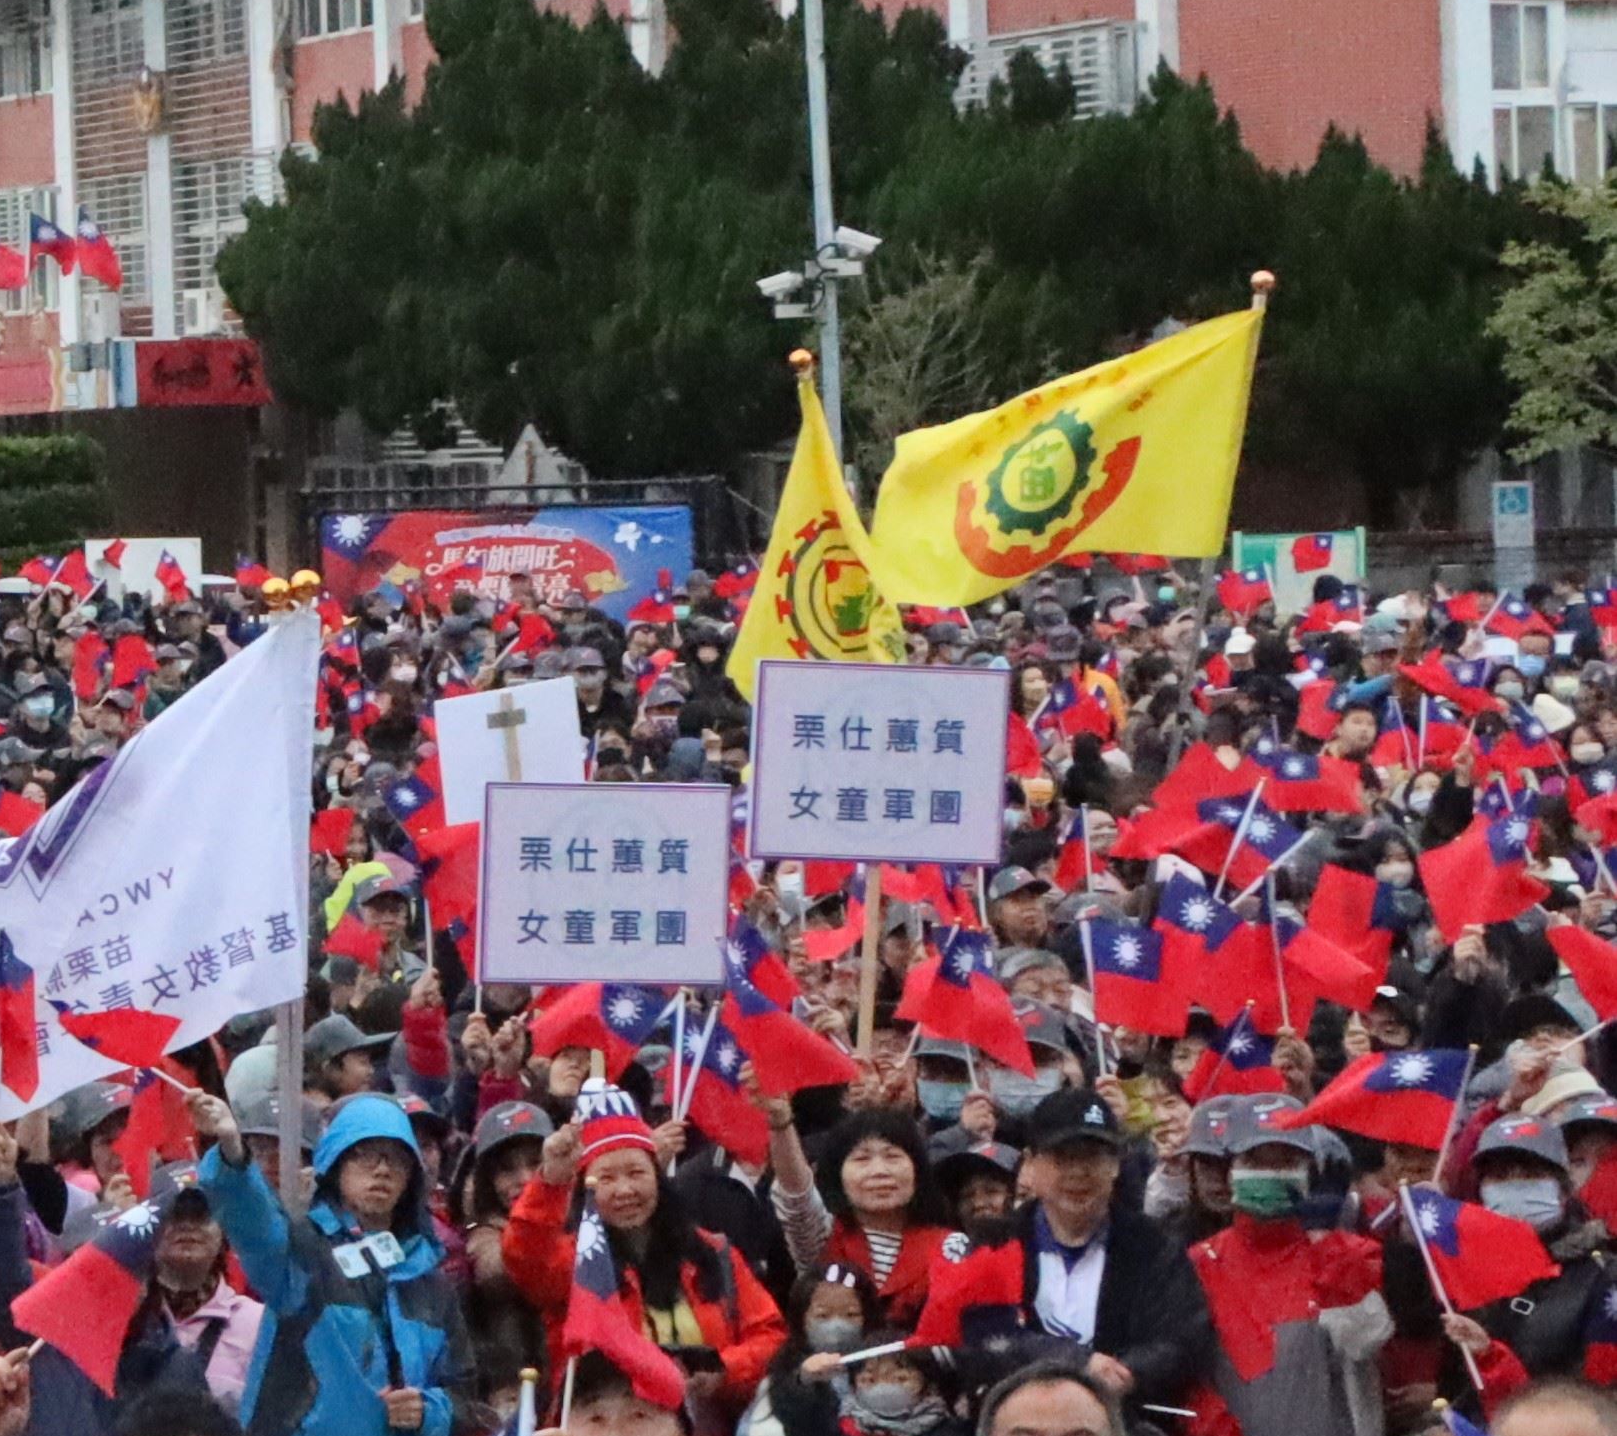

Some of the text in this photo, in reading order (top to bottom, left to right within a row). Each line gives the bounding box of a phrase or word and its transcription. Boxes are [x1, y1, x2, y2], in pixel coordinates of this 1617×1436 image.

[788, 785, 963, 826] 女童軍團
[517, 909, 688, 947] 女童軍團
